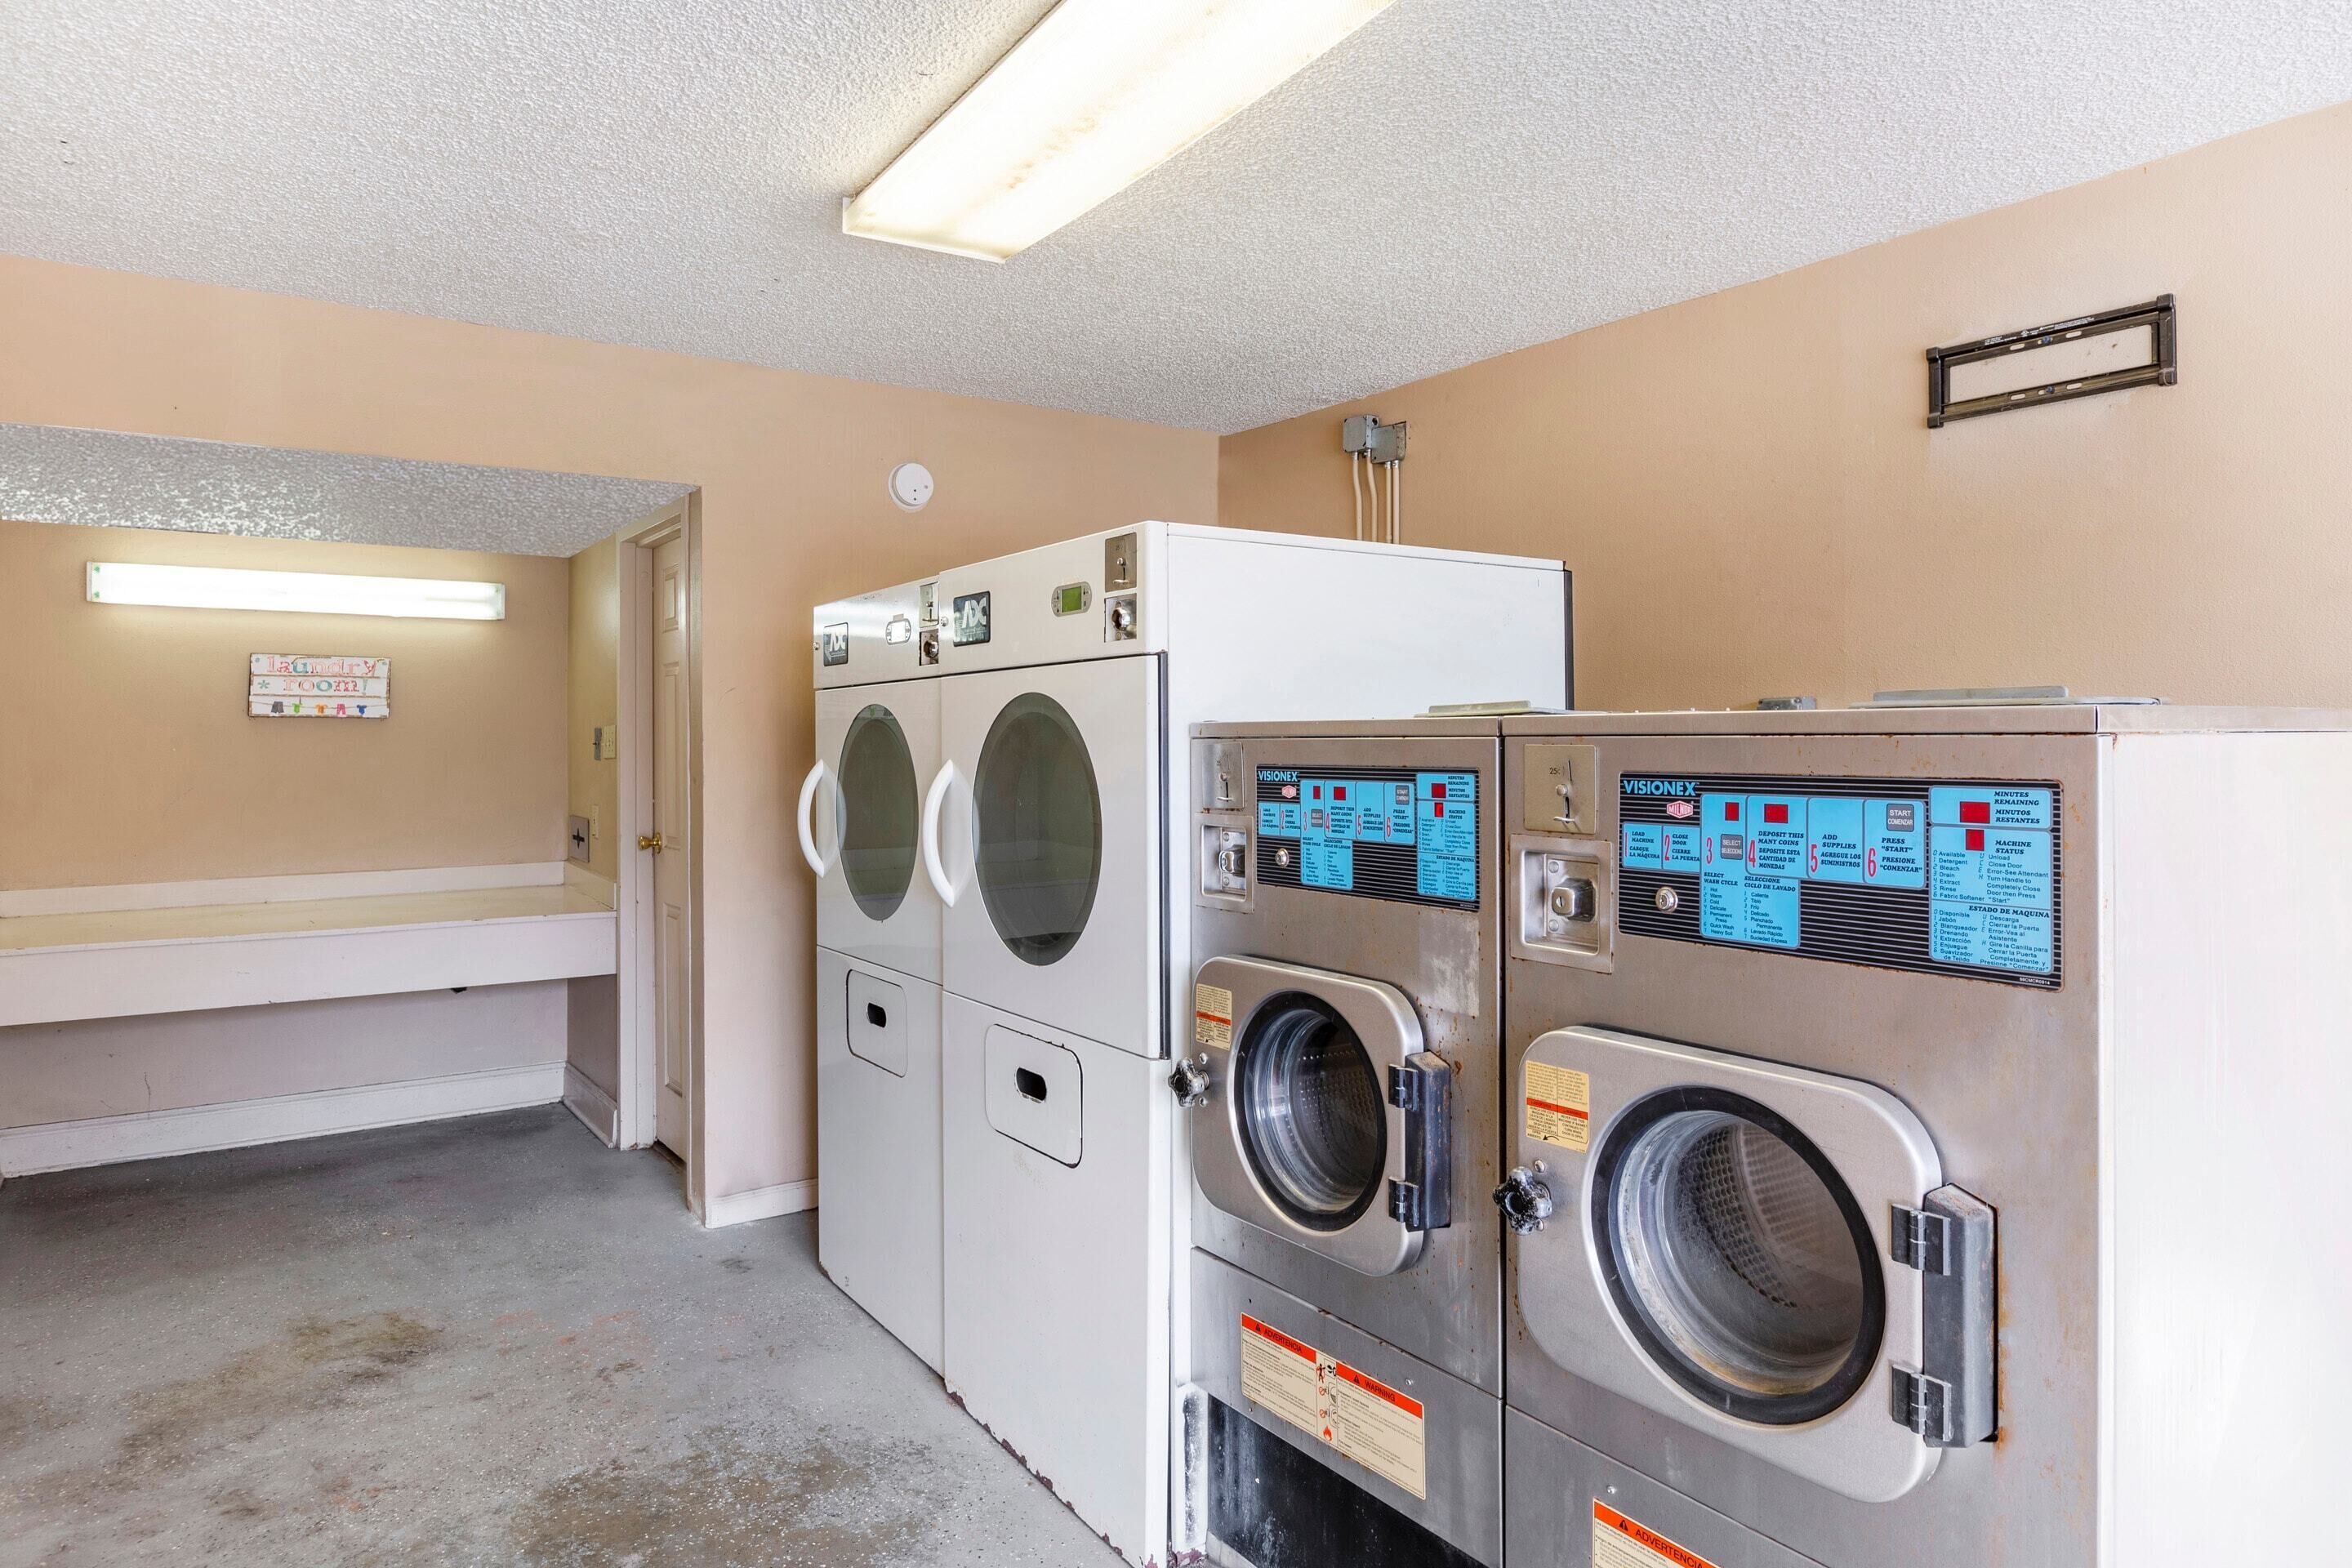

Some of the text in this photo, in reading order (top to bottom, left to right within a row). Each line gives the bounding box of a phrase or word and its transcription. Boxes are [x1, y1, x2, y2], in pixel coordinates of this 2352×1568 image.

[962, 597, 987, 628] ADC
[266, 656, 377, 676] laundry
[283, 679, 368, 696] room!
[1258, 771, 1298, 782] VISIONEX
[1624, 781, 1695, 795] VISIONEX
[1387, 817, 1391, 837] 6
[1664, 835, 1669, 861] 2
[1707, 837, 1712, 864] 3
[1748, 840, 1756, 867] 4
[1811, 844, 1817, 872] 5
[1868, 848, 1876, 877] 6
[1987, 883, 2020, 891] Completely
[2012, 910, 2049, 918] MAQUINA
[1940, 923, 1977, 931] Blanqueador
[1989, 928, 2018, 936] Error-Vea
[1989, 934, 2017, 942] Asistente
[1980, 959, 2007, 967] Presione
[1990, 955, 2038, 964] Completamente
[1264, 1330, 1303, 1353] ADVERTENCIA
[1365, 1380, 1396, 1401] WARNING
